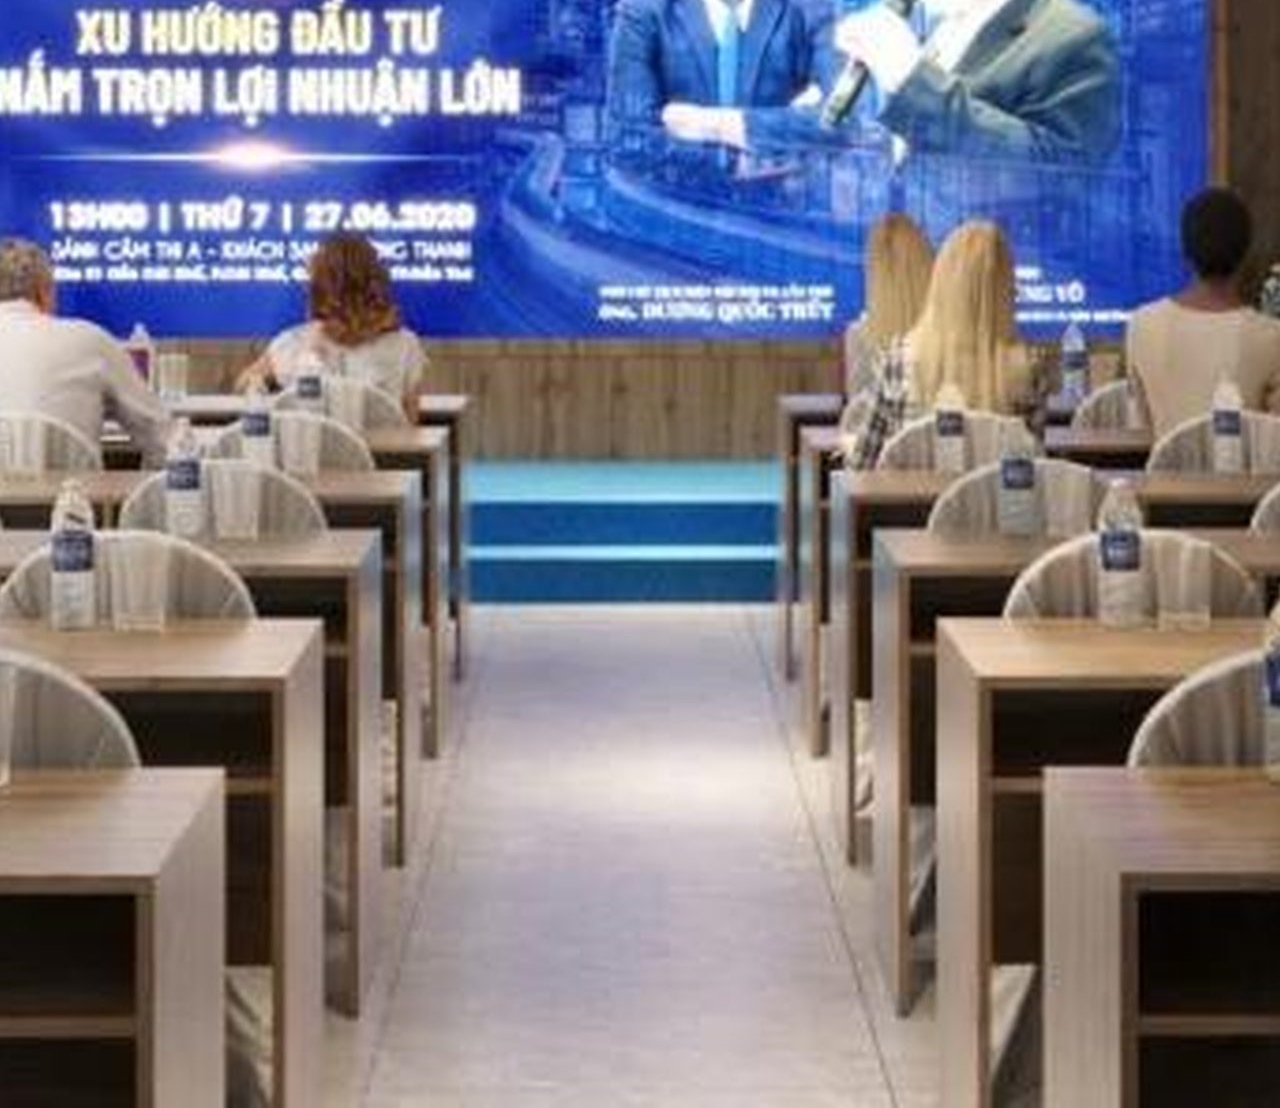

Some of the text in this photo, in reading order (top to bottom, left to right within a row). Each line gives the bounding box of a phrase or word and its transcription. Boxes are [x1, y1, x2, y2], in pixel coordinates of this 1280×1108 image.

[76, 9, 129, 55] XU
[143, 0, 279, 55] HƯỚNG
[385, 6, 441, 55] TƯ
[94, 69, 201, 127] TRỌN
[215, 65, 278, 127] LỢI
[290, 58, 428, 127] NHUẬN
[441, 58, 521, 114] LỚN
[249, 203, 269, 231] 7
[305, 202, 475, 231] 27.06.2020
